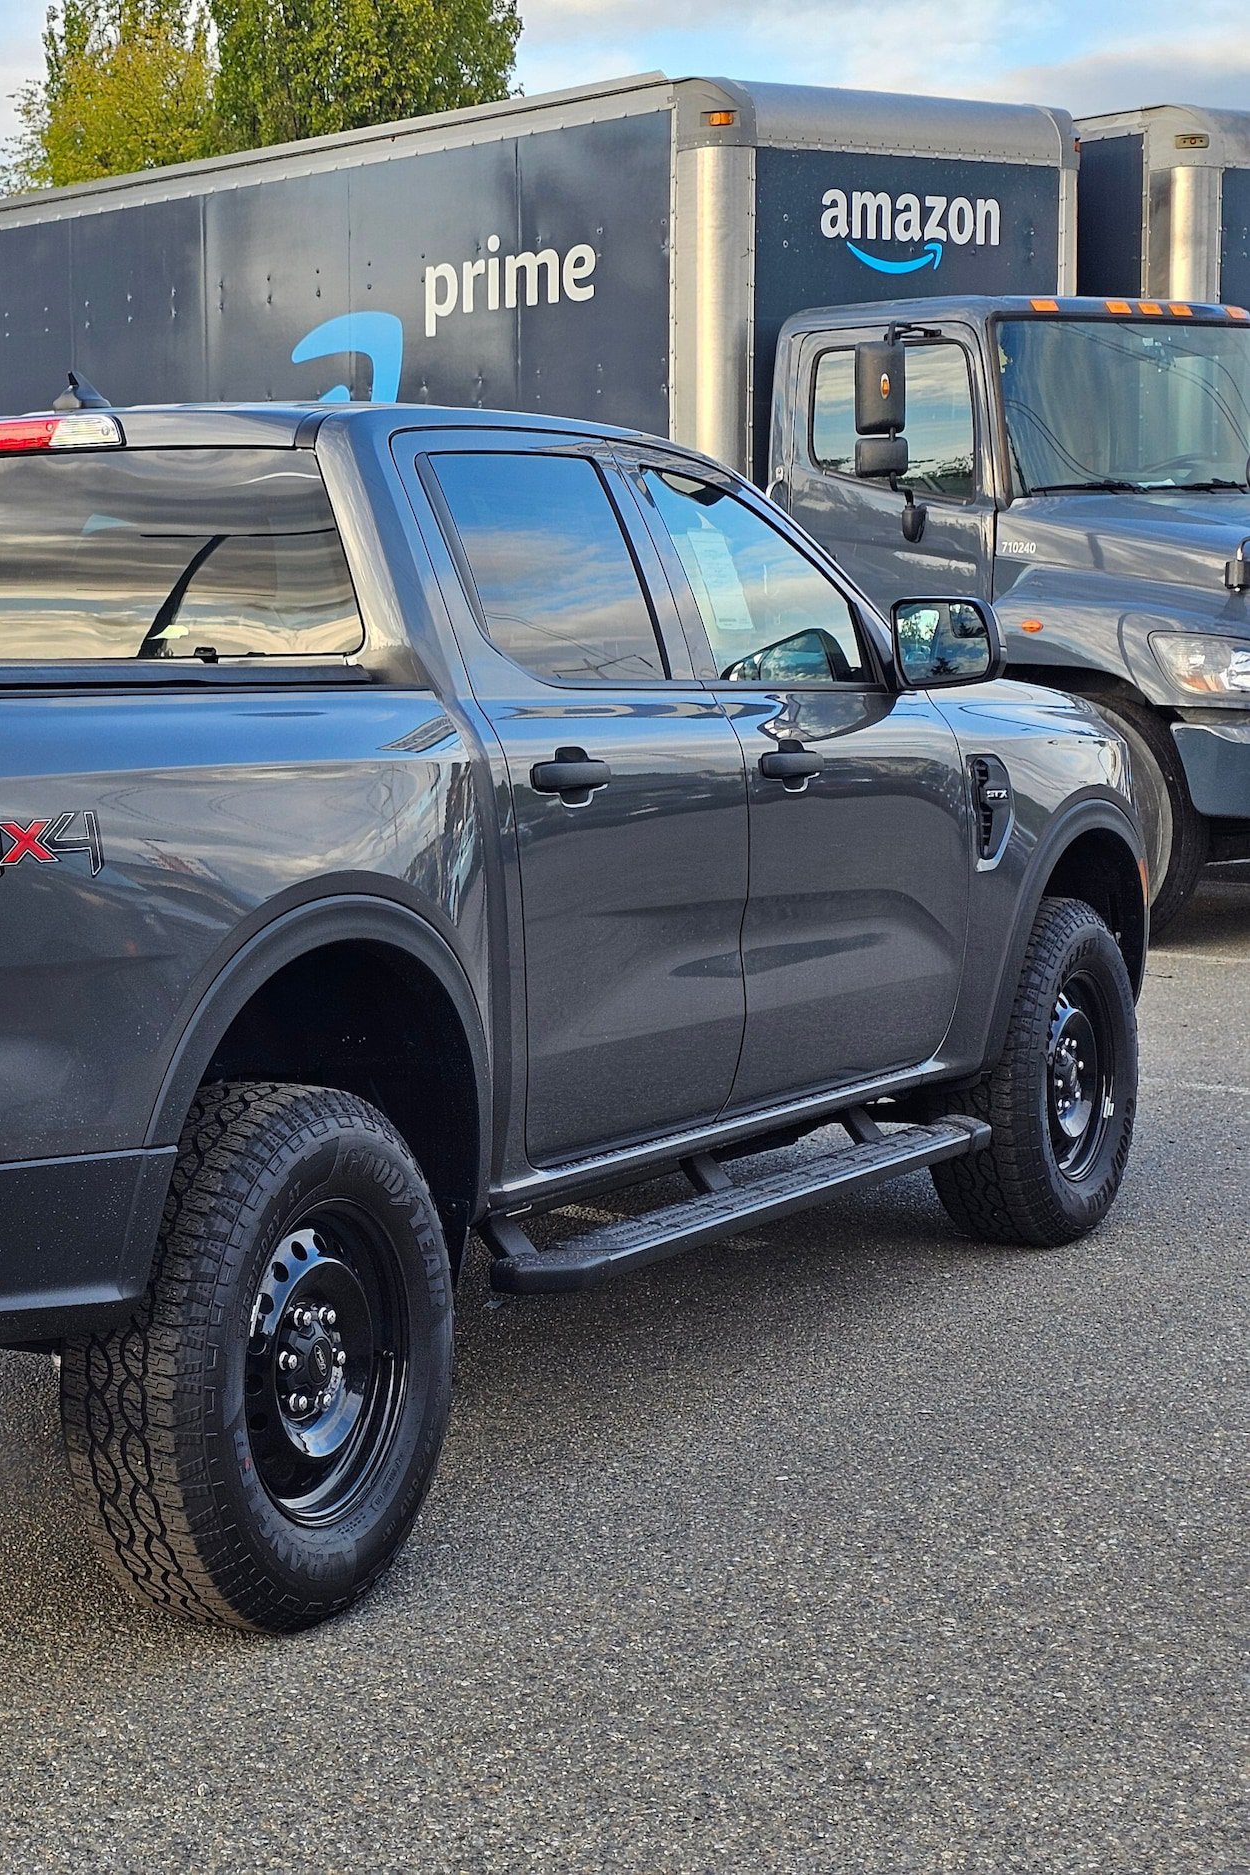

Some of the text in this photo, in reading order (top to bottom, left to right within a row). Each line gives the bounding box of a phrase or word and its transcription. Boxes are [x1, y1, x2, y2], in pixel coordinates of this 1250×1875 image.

[820, 188, 1000, 246] amazon
[425, 234, 596, 338] prime
[1001, 541, 1037, 554] 710240
[985, 789, 1008, 799] STX
[343, 1148, 447, 1308] GOODYEAR
